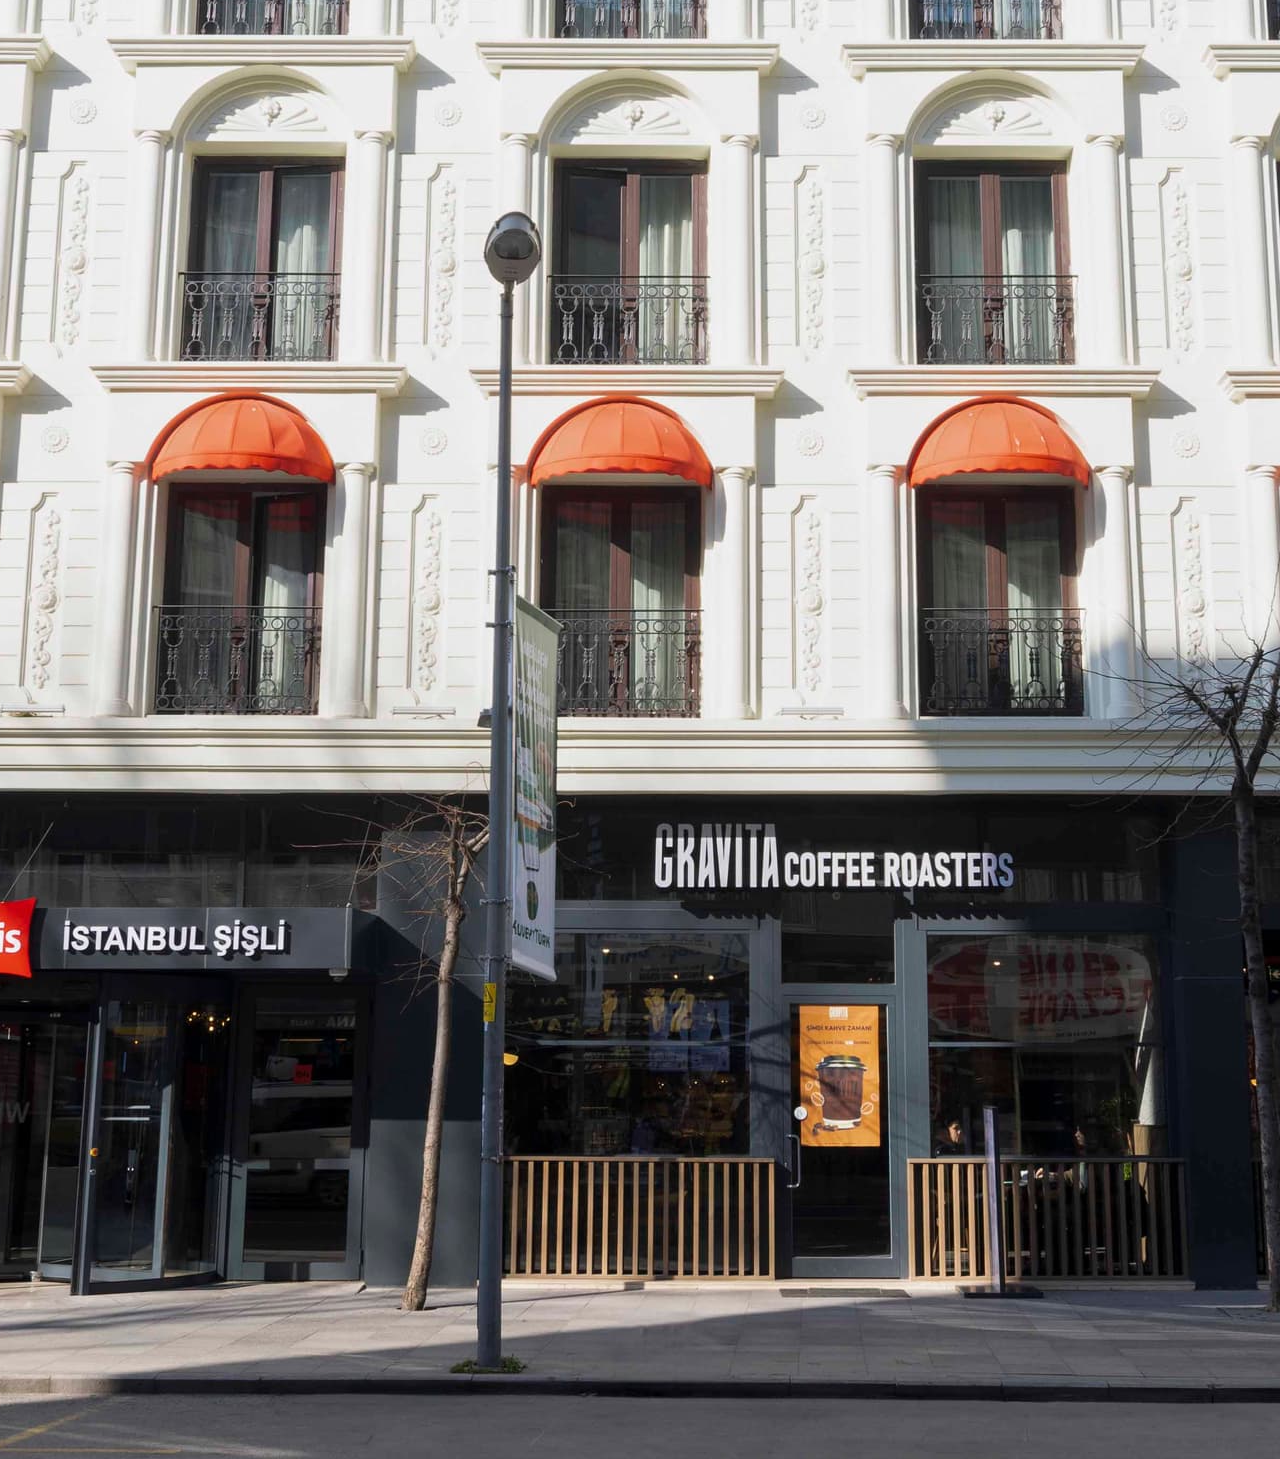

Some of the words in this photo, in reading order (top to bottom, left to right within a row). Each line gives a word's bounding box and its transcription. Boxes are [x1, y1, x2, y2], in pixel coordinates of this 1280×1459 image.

[654, 823, 780, 889] GRAVITA
[783, 851, 875, 888] COFFEE
[883, 851, 1015, 888] ROASTERS
[62, 919, 207, 952] İSTANBUL
[212, 919, 287, 957] ŞİŞLİ
